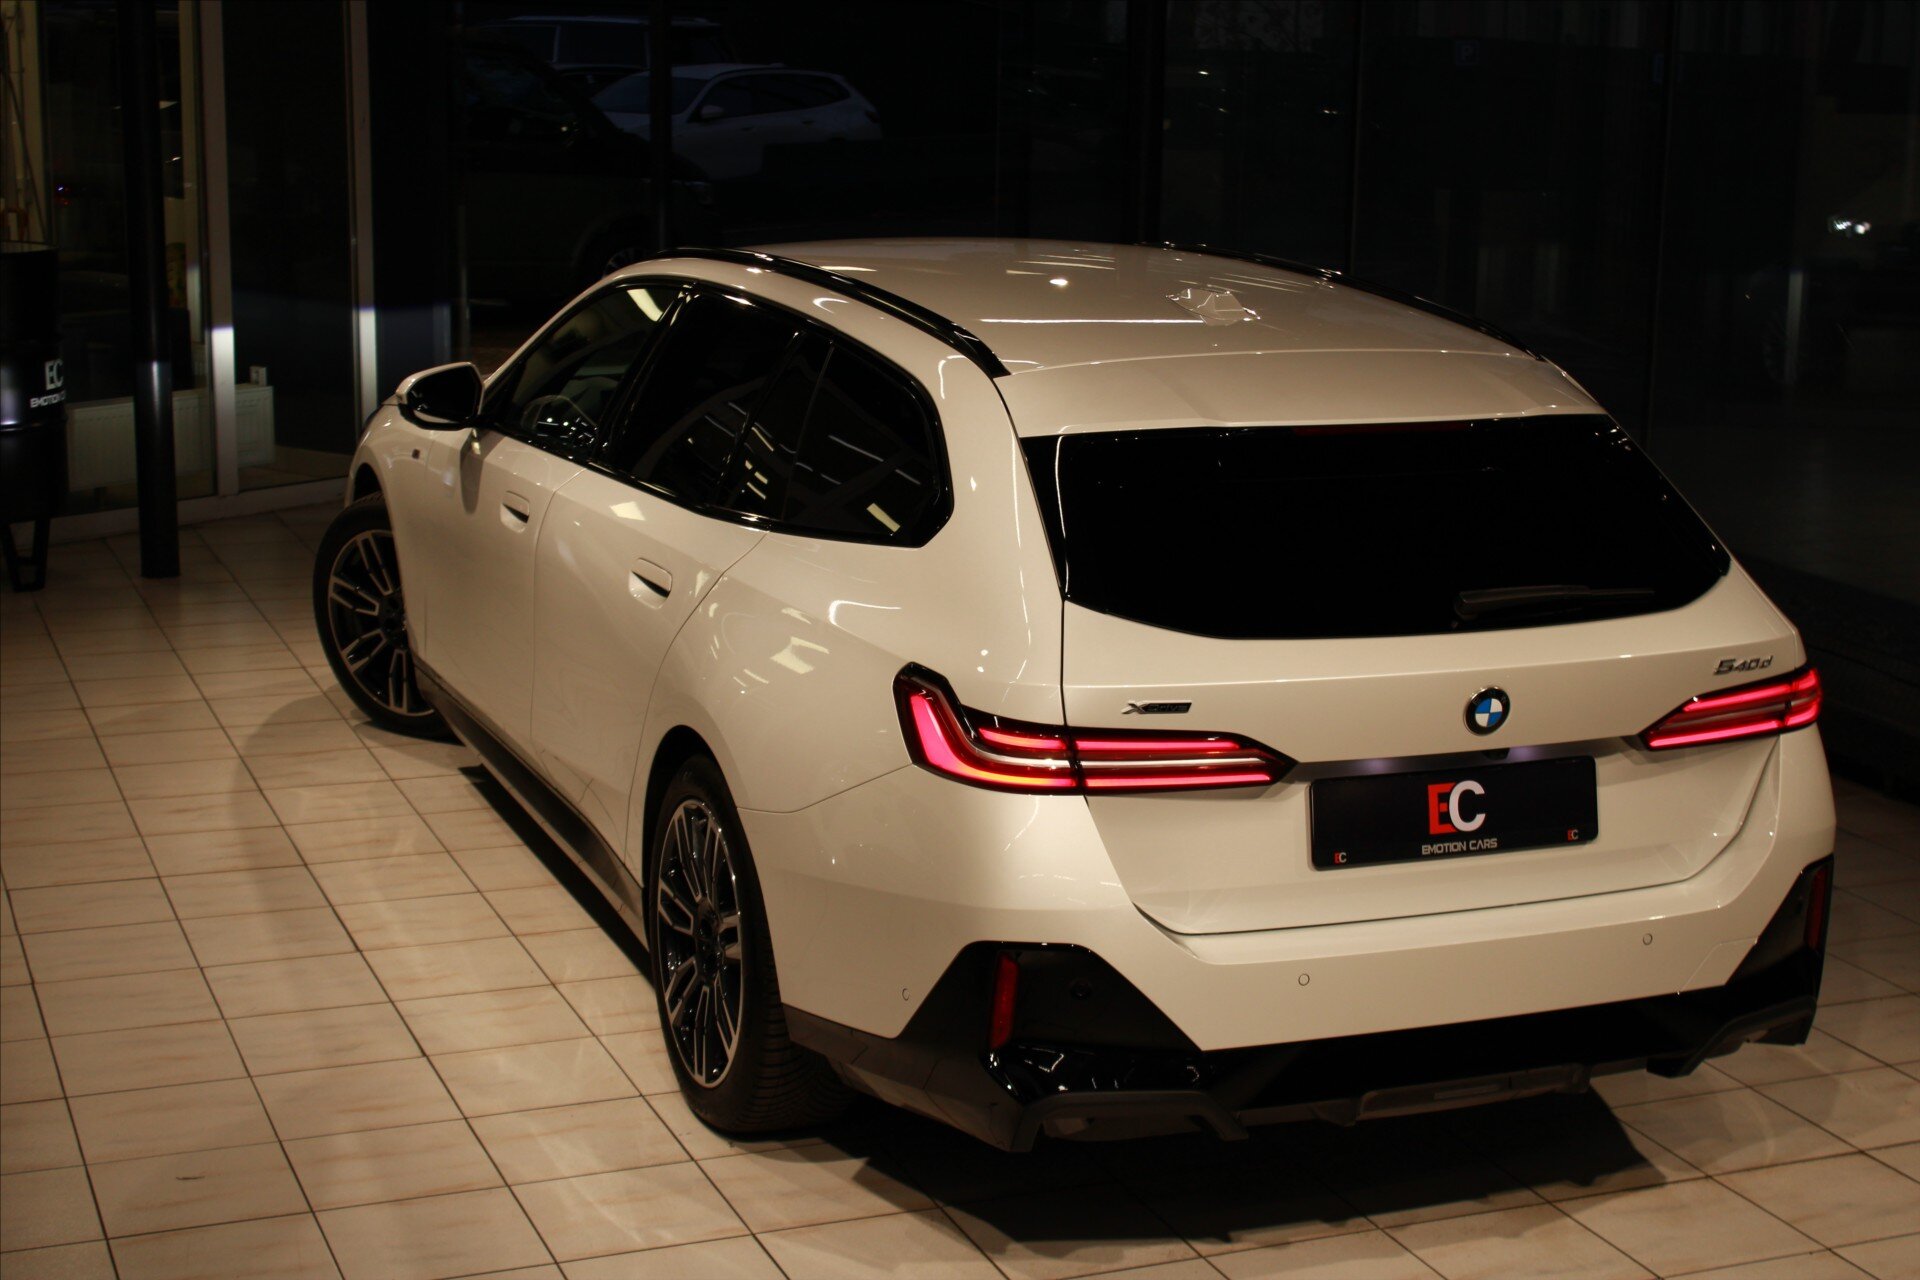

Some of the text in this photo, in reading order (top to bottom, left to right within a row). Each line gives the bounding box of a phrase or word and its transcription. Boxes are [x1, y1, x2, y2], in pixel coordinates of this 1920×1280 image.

[1713, 655, 1773, 675] 540d
[1427, 780, 1486, 835] EC
[1422, 838, 1498, 855] EMOTION CARS
